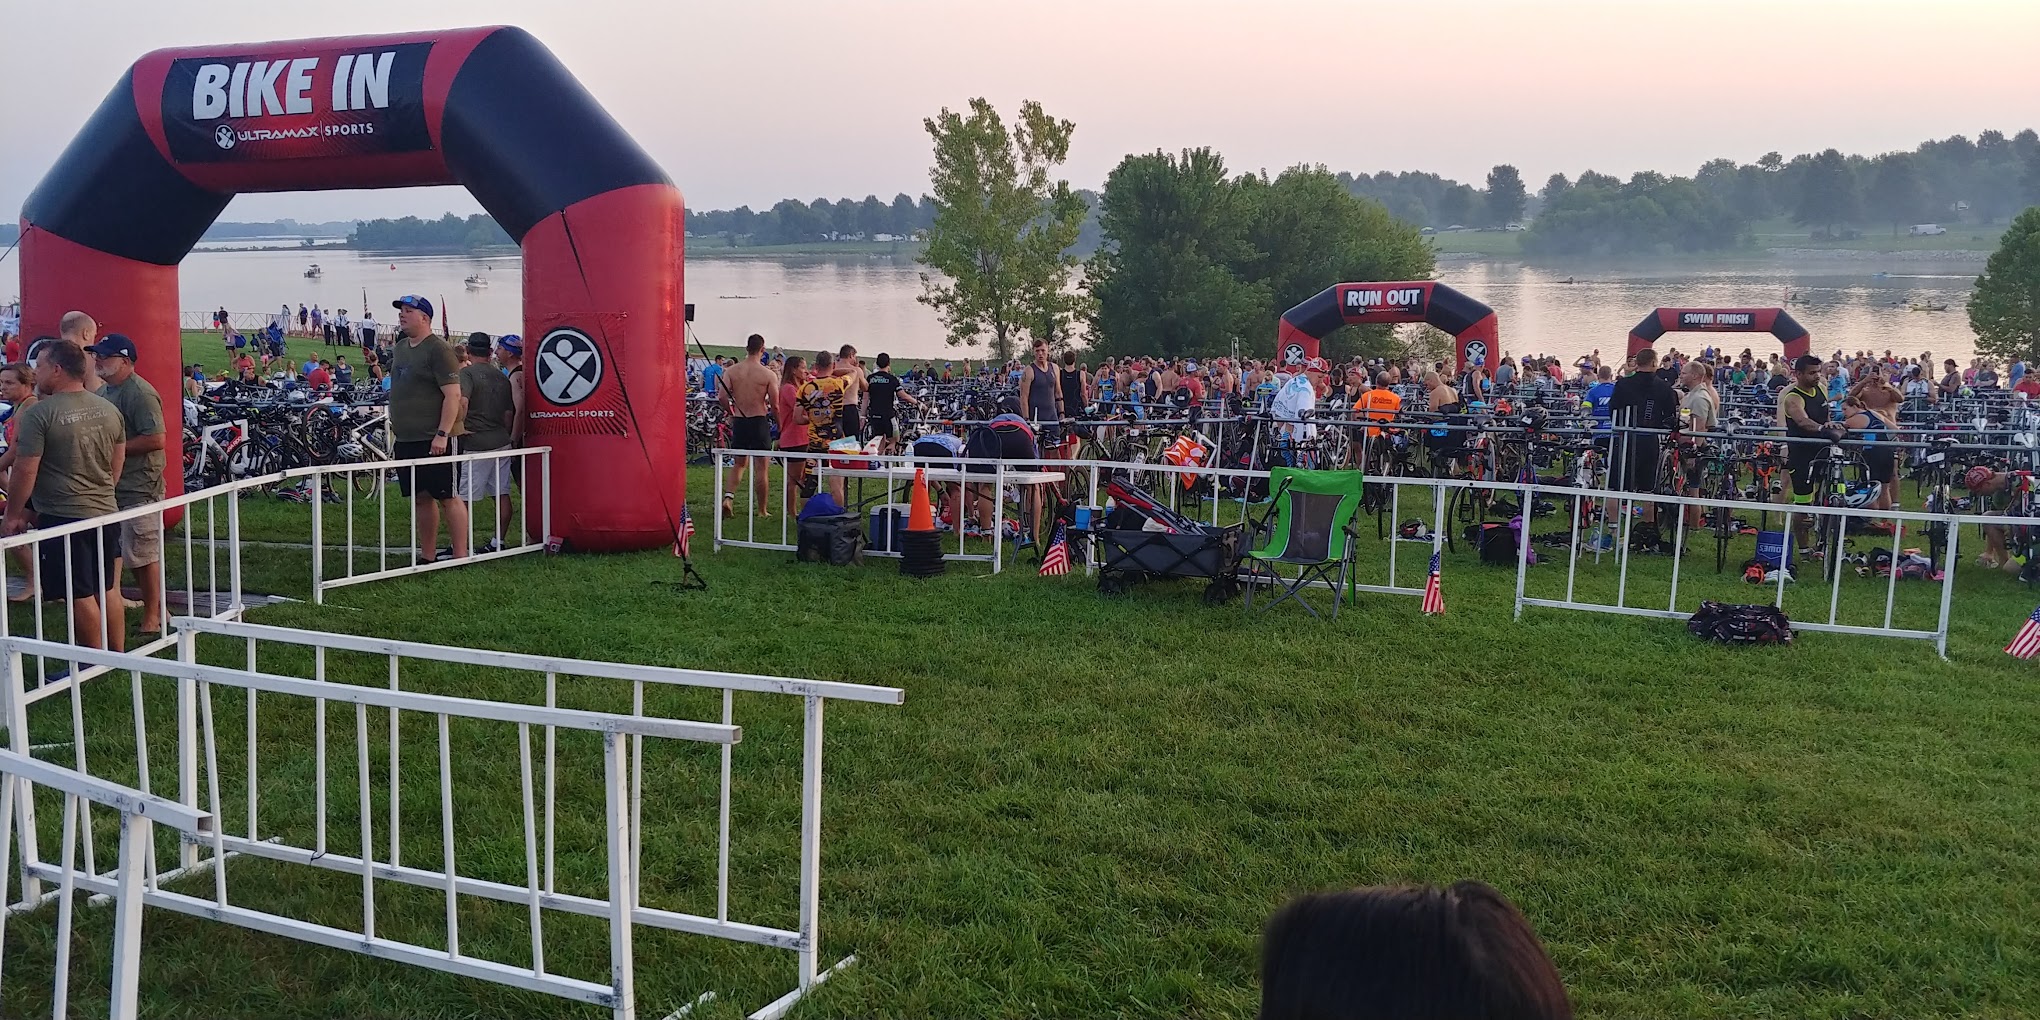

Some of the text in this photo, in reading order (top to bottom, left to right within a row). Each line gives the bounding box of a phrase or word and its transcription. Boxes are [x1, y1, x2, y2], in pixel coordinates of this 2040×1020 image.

[193, 52, 396, 120] BIKE IN
[237, 122, 374, 142] ULTRAMAX SPORTS
[1347, 289, 1421, 307] RUN OUT
[1684, 313, 1750, 325] SWIM FINISH
[530, 410, 615, 419] ULTRAMAX SPORTS
[1759, 544, 1784, 553] OWE'S
